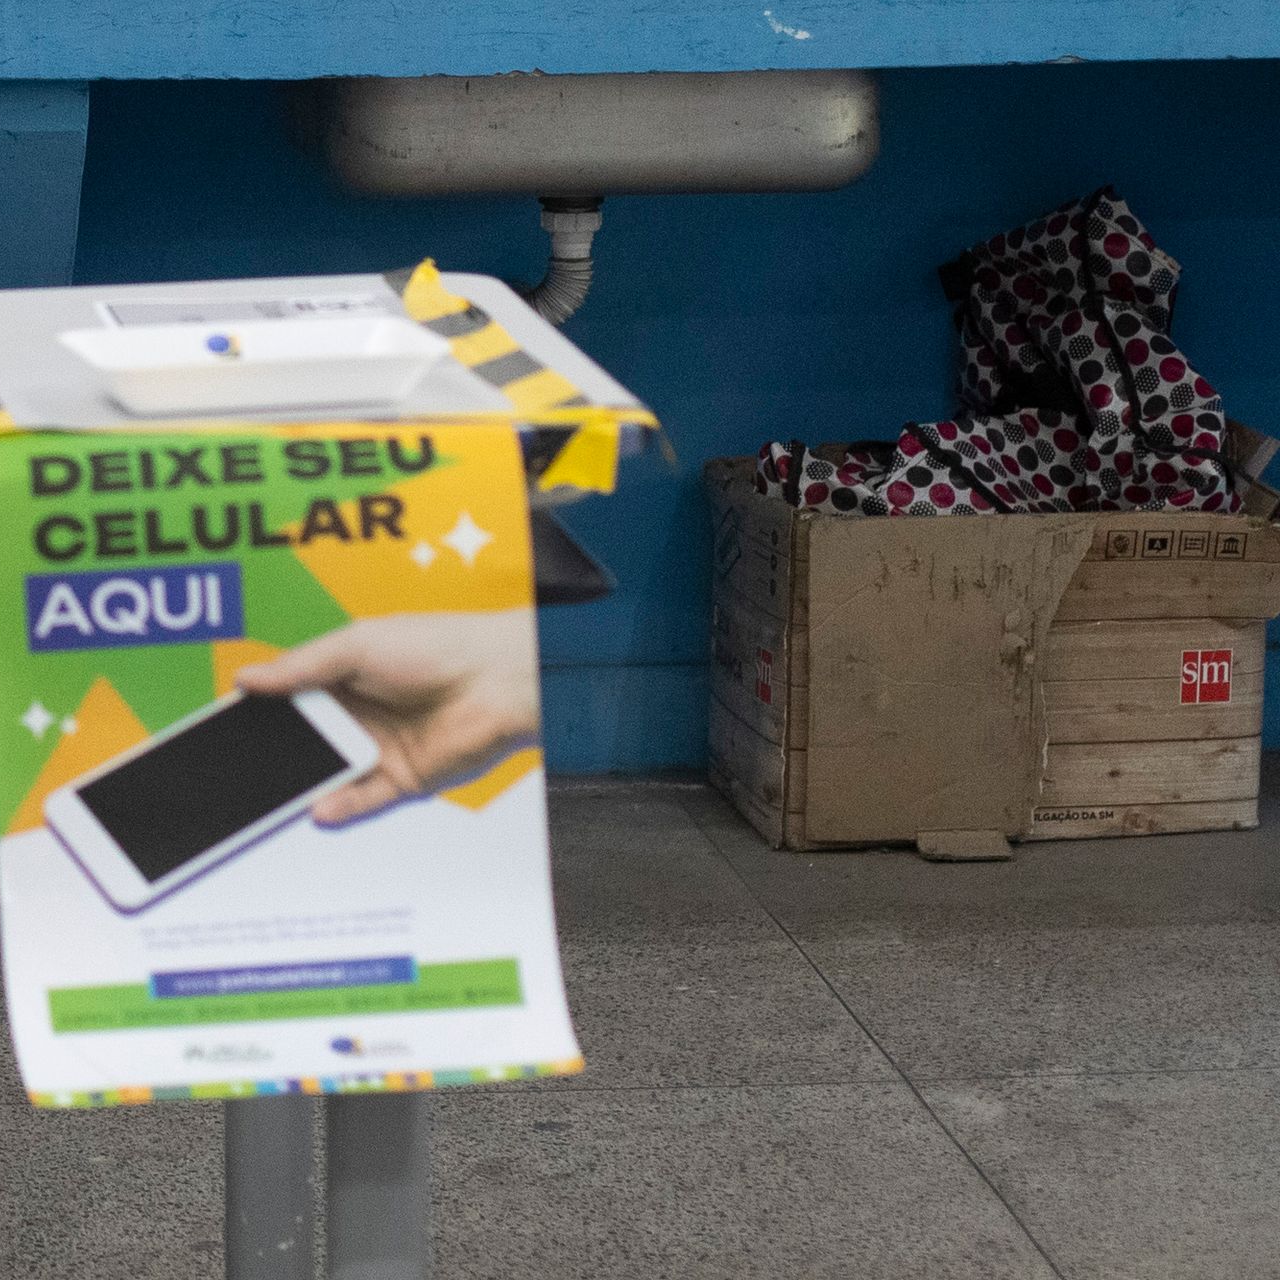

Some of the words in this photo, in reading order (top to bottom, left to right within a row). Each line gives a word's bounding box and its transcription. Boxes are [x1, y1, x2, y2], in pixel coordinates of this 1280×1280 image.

[30, 443, 266, 496] DEIXE
[282, 434, 437, 481] SEU
[34, 494, 406, 562] CELULAR
[34, 572, 224, 638] AQUI
[1182, 661, 1230, 685] sm
[1081, 811, 1096, 821] DA
[1098, 810, 1114, 820] SM
